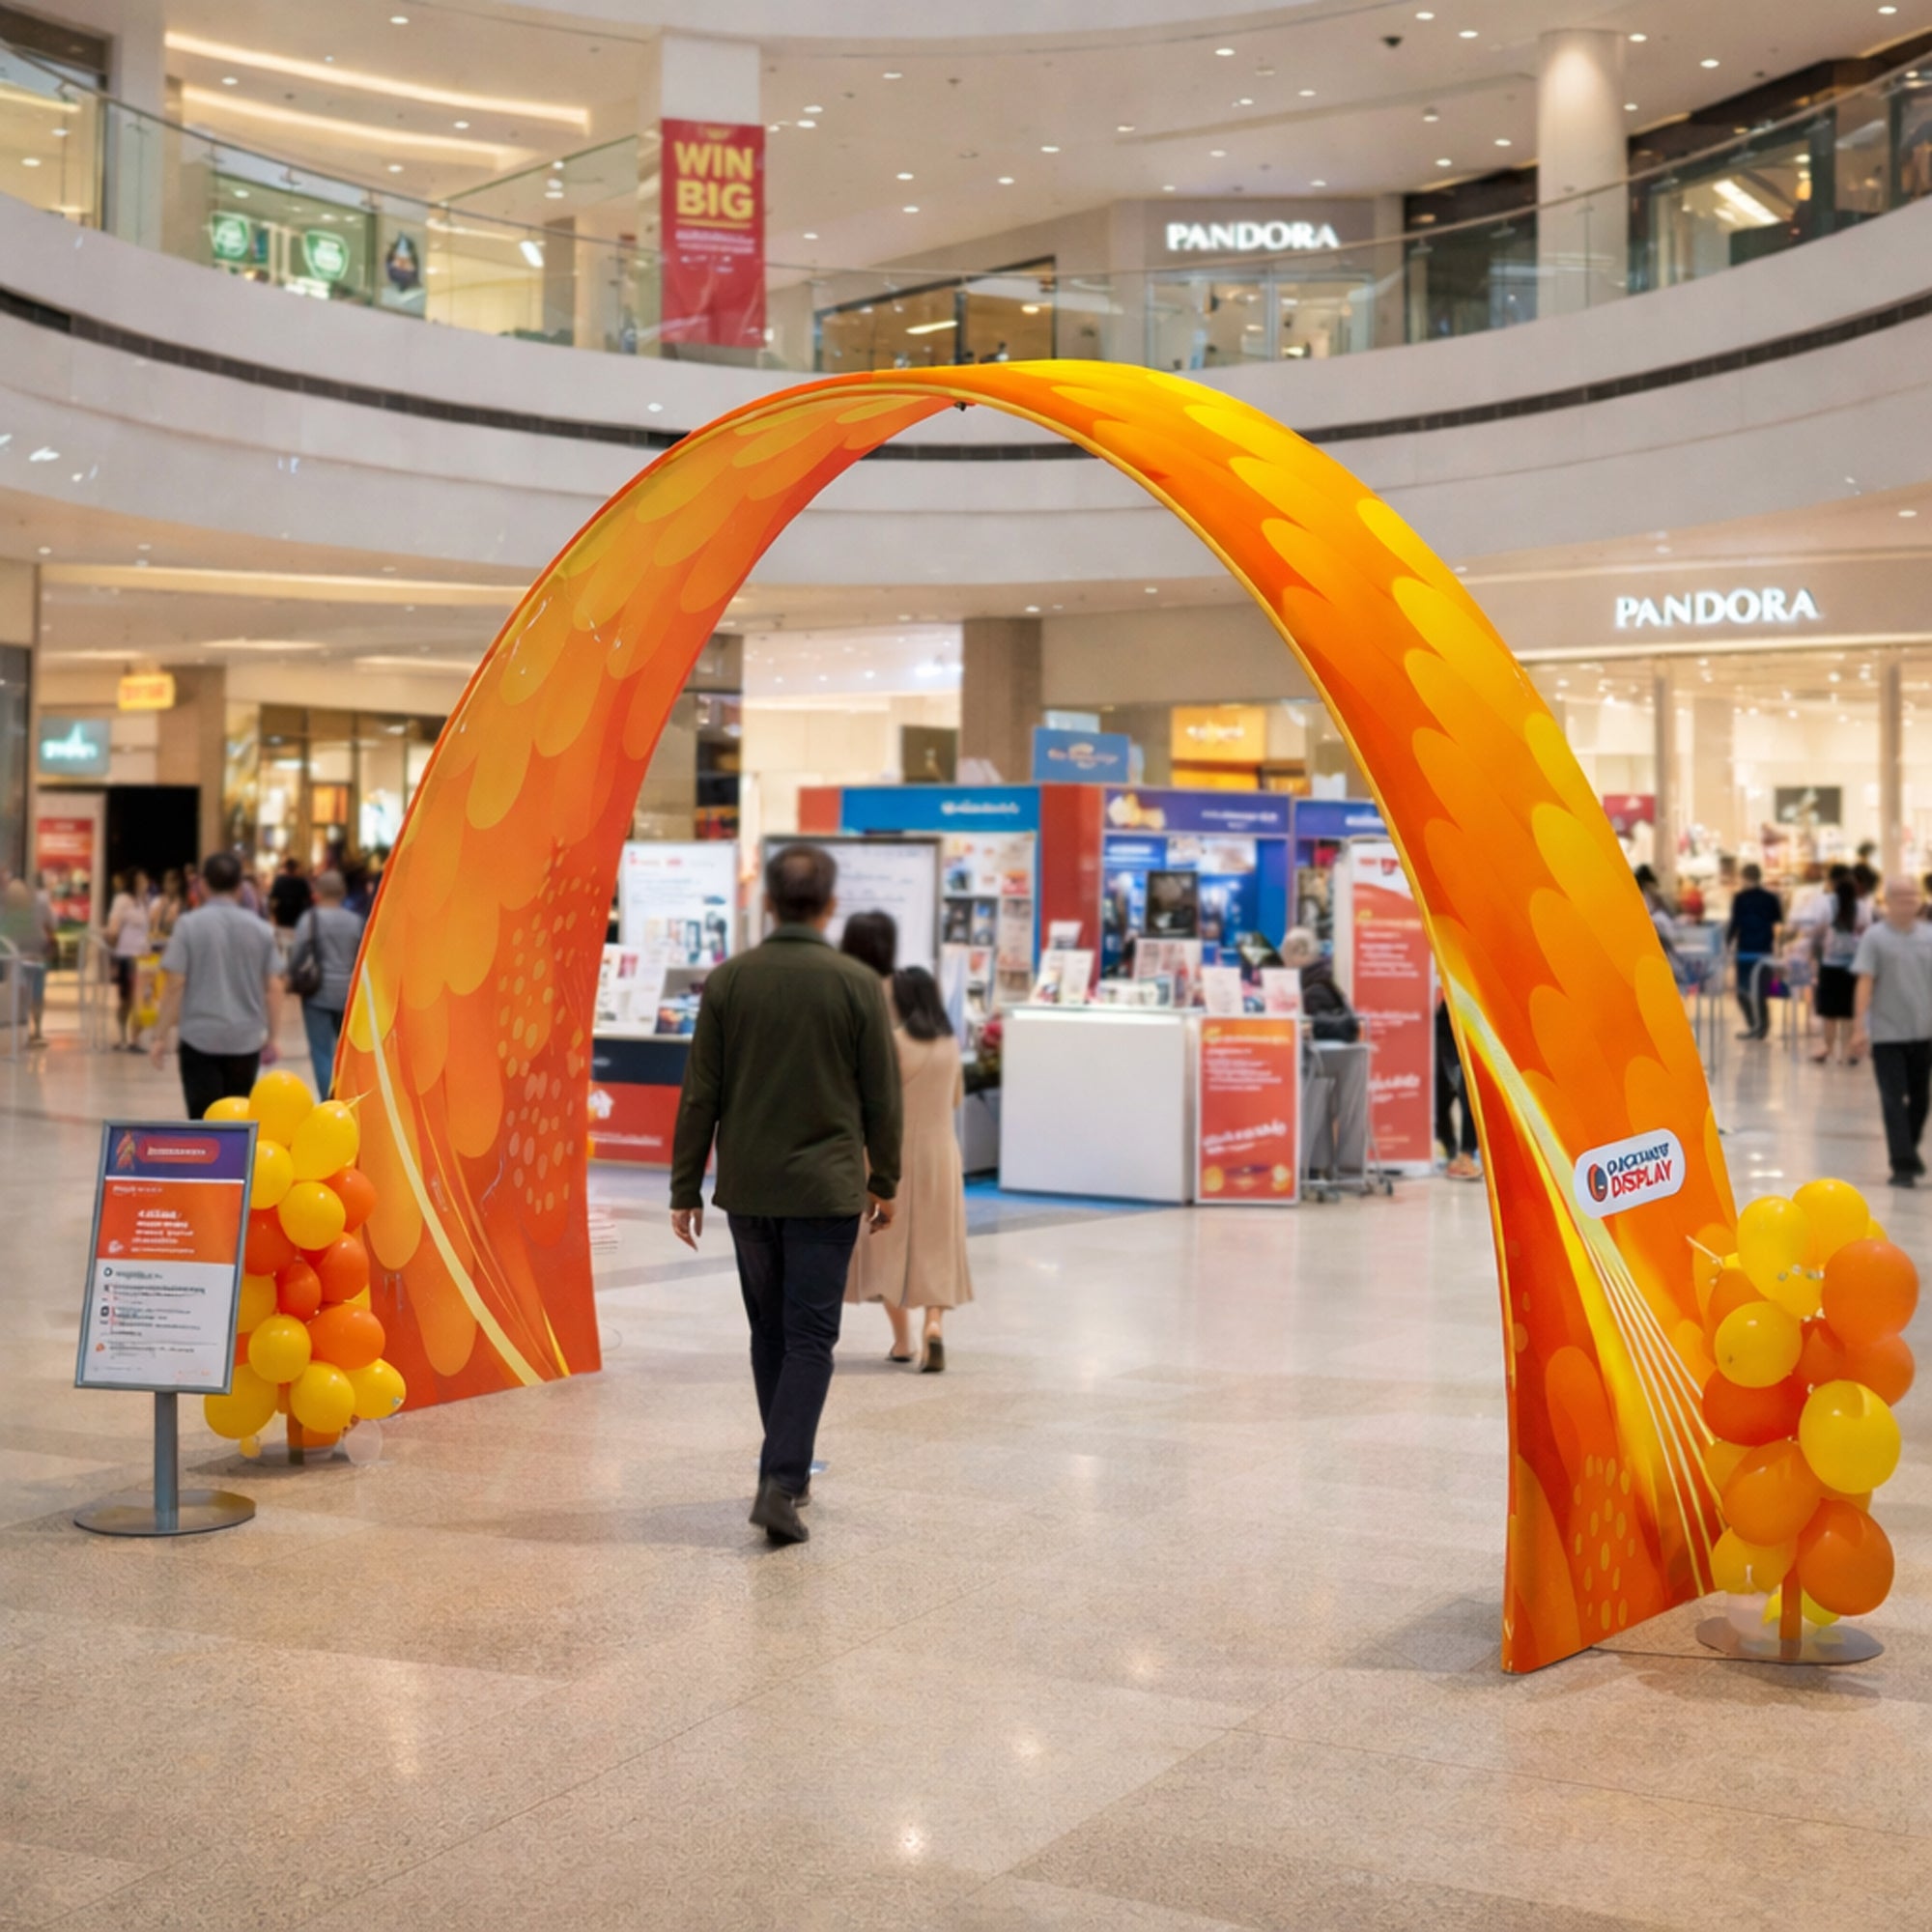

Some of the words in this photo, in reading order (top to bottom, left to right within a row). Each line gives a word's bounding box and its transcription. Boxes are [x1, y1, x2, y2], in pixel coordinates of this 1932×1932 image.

[674, 141, 754, 182] WIN
[677, 180, 754, 220] BIG
[1166, 221, 1341, 251] PANDORA
[1615, 586, 1820, 628] PANDORA
[1611, 1159, 1672, 1198] DISPLAY
